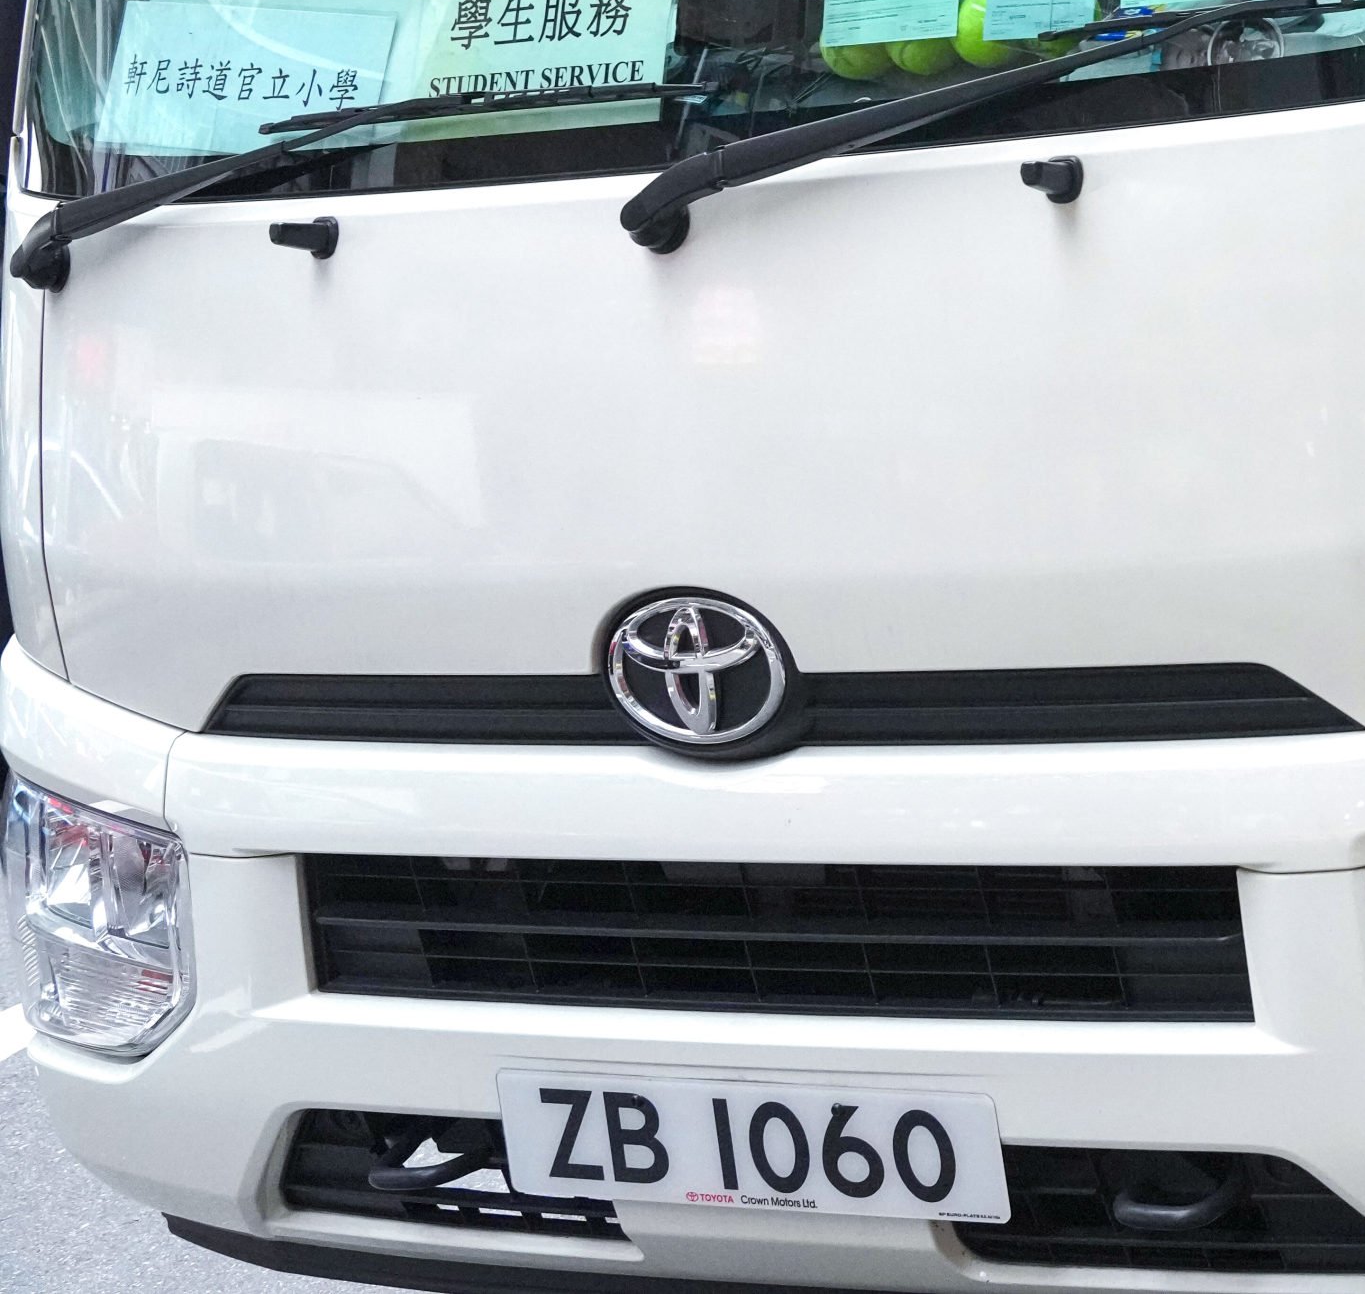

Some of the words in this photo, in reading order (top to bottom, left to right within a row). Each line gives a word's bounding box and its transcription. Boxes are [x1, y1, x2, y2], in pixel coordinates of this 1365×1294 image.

[122, 52, 361, 110] 軒尼詩道官立小學
[428, 67, 531, 97] STUDENT
[538, 59, 645, 89] SERVICE
[538, 1086, 670, 1185] ZB
[711, 1096, 957, 1204] 1060
[699, 1193, 735, 1204] TOYOTA
[740, 1194, 770, 1207] Crown
[770, 1196, 802, 1209] Motors
[801, 1198, 819, 1210] Ltd.
